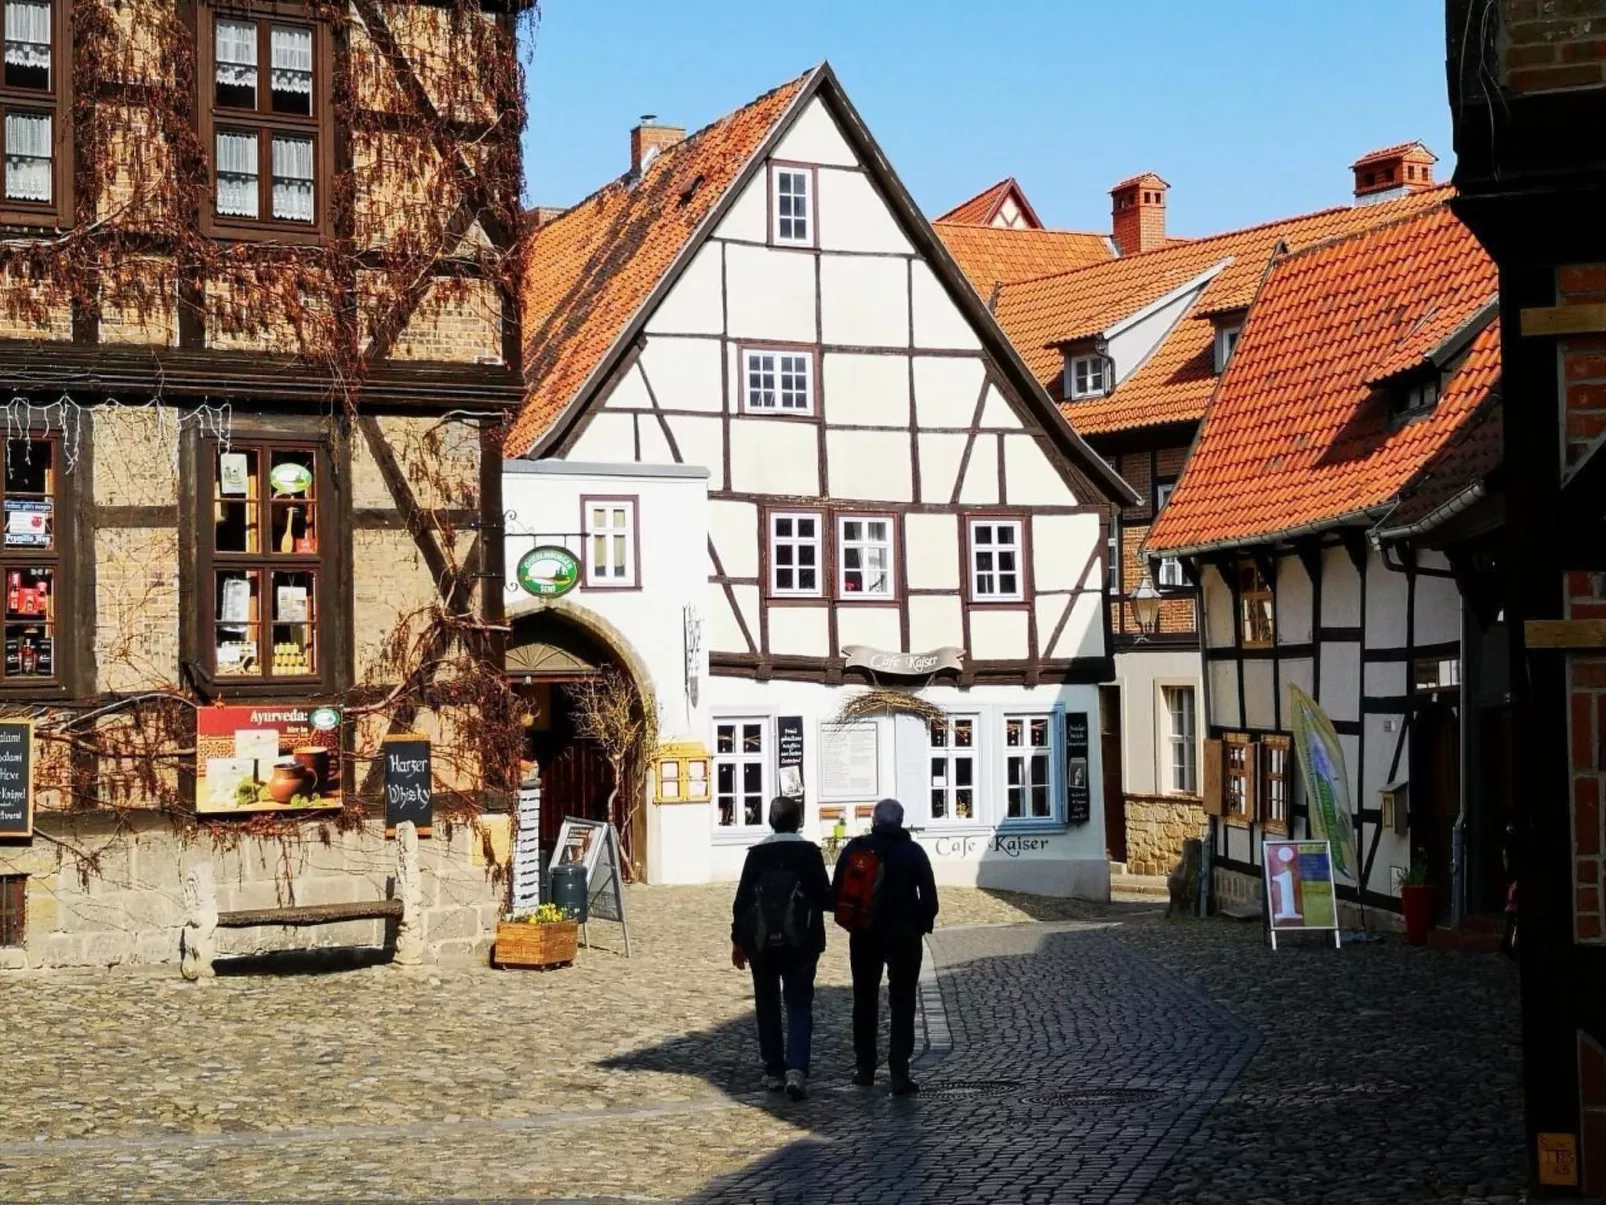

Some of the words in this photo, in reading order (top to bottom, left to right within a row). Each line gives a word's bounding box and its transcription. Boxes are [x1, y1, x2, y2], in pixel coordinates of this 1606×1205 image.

[905, 655, 938, 673] Kaiser
[250, 708, 309, 725] Ayurveda:
[389, 754, 428, 778] Harzer
[387, 783, 431, 810] Whisky
[988, 835, 1049, 858] Kaiser
